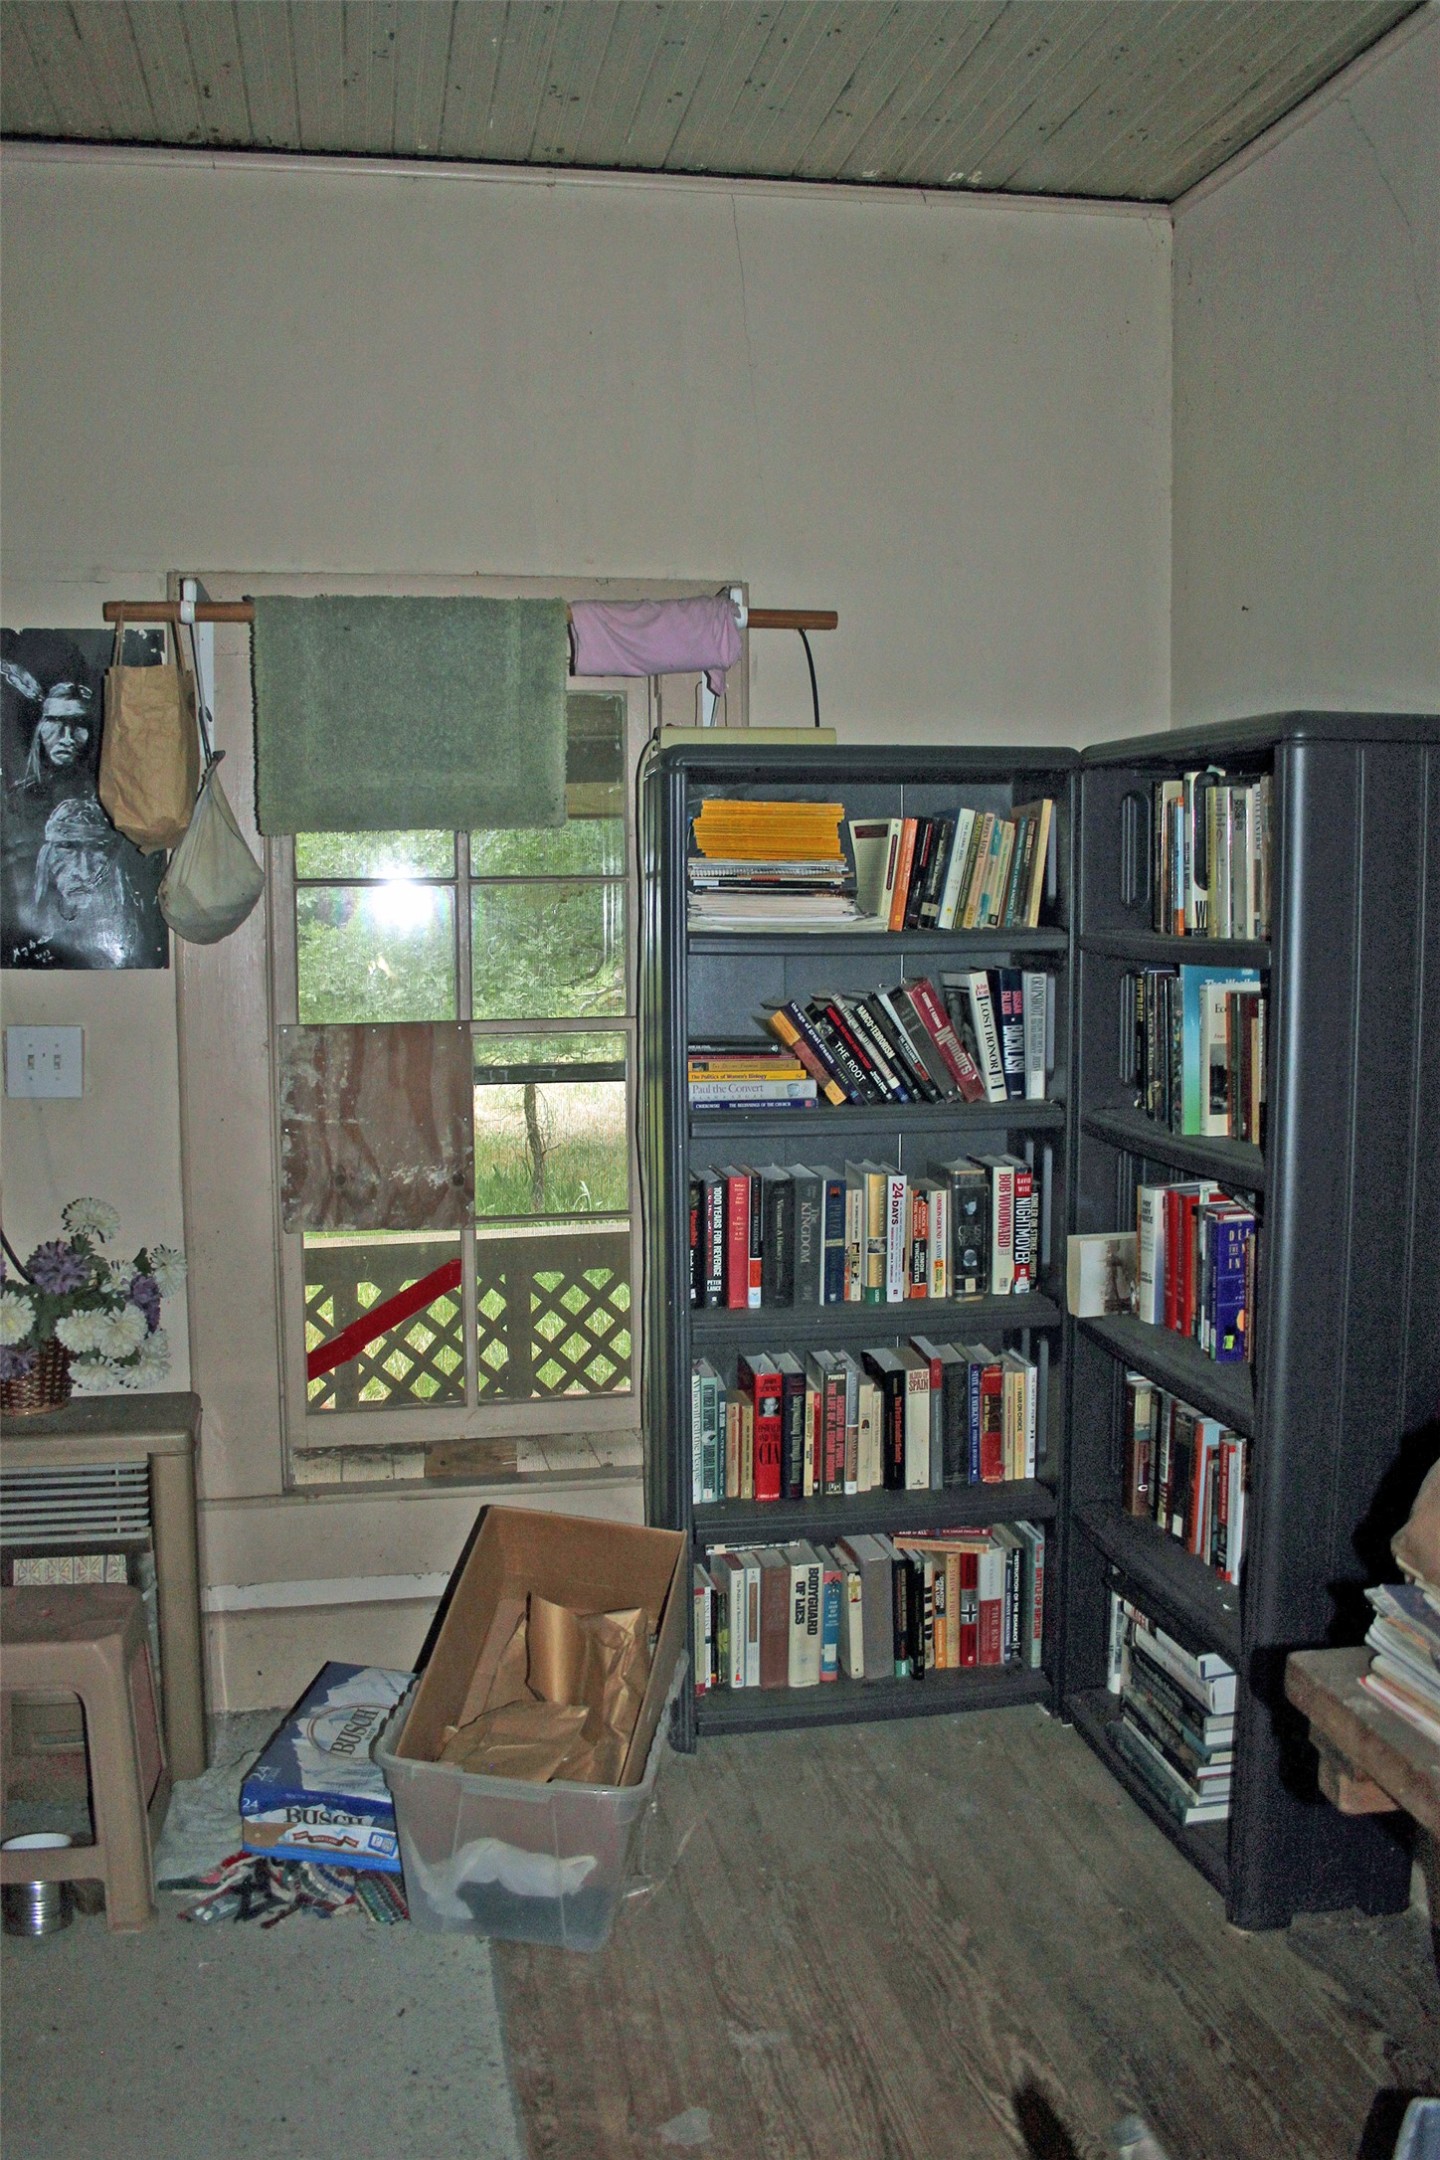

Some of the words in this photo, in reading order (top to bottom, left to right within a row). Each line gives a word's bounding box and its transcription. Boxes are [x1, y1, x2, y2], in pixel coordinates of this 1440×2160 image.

[1008, 889, 1017, 910] AMERICA
[1002, 991, 1012, 1014] FALUDI
[1013, 991, 1023, 1014] SUSAN
[1032, 975, 1044, 1018] CRAPSHOOT
[980, 1002, 992, 1028] LOST
[856, 1005, 896, 1059] NARCO-TERRORISM
[809, 1028, 821, 1045] great
[819, 1043, 834, 1064] dreams
[934, 1025, 972, 1076] Memoirs
[985, 1030, 999, 1069] HONOR
[1003, 1025, 1025, 1073] BACKLASH
[834, 1041, 850, 1061] THE
[847, 1060, 867, 1082] ROOT
[749, 1073, 767, 1081] Biology
[692, 1085, 708, 1094] Paul
[712, 1084, 726, 1093] the
[728, 1084, 764, 1093] Convert
[892, 1182, 904, 1199] 24
[999, 1173, 1012, 1193] BOB
[713, 1186, 722, 1205] 1000
[713, 1206, 722, 1229] YEARS
[998, 1194, 1011, 1248] WOODWARD
[713, 1230, 722, 1244] FOR
[800, 1202, 811, 1264] KINGDOM
[1015, 1197, 1030, 1265] NIGHTMOVER
[713, 1245, 722, 1277] REVENGE
[776, 1238, 784, 1261] History
[909, 1373, 922, 1381] BLOOD
[909, 1379, 929, 1392] SPAIN
[703, 1385, 715, 1407] OCTOBER
[827, 1382, 837, 1396] THE
[827, 1397, 836, 1411] LIFE
[837, 1395, 845, 1426] SECRECY
[894, 1396, 902, 1406] The
[1017, 1403, 1023, 1412] ON
[703, 1408, 715, 1431] SURPRISE
[790, 1396, 802, 1435] Sleepwalking
[827, 1412, 836, 1421] OF
[894, 1407, 902, 1420] First
[826, 1430, 836, 1453] EDGAR
[894, 1420, 902, 1443] Socialist
[703, 1445, 715, 1467] BARBARA
[759, 1443, 780, 1465] CIA
[791, 1438, 803, 1461] Through
[836, 1442, 844, 1468] POWER
[894, 1443, 902, 1463] Society
[693, 1452, 701, 1482] People
[791, 1462, 802, 1484] History
[826, 1454, 836, 1482] HOOVER
[796, 1581, 806, 1596] OF
[1035, 1567, 1043, 1594] BATTLE
[807, 1567, 819, 1636] BODYGUARD
[1013, 1593, 1019, 1601] OF
[1034, 1595, 1042, 1606] OF
[795, 1598, 805, 1625] LIES
[991, 1606, 999, 1626] THE
[1033, 1607, 1042, 1639] BRITAIN
[991, 1628, 999, 1649] END
[331, 1709, 379, 1755] BUSCH
[242, 1798, 259, 1809] 24
[284, 1807, 364, 1825] BUSCH
